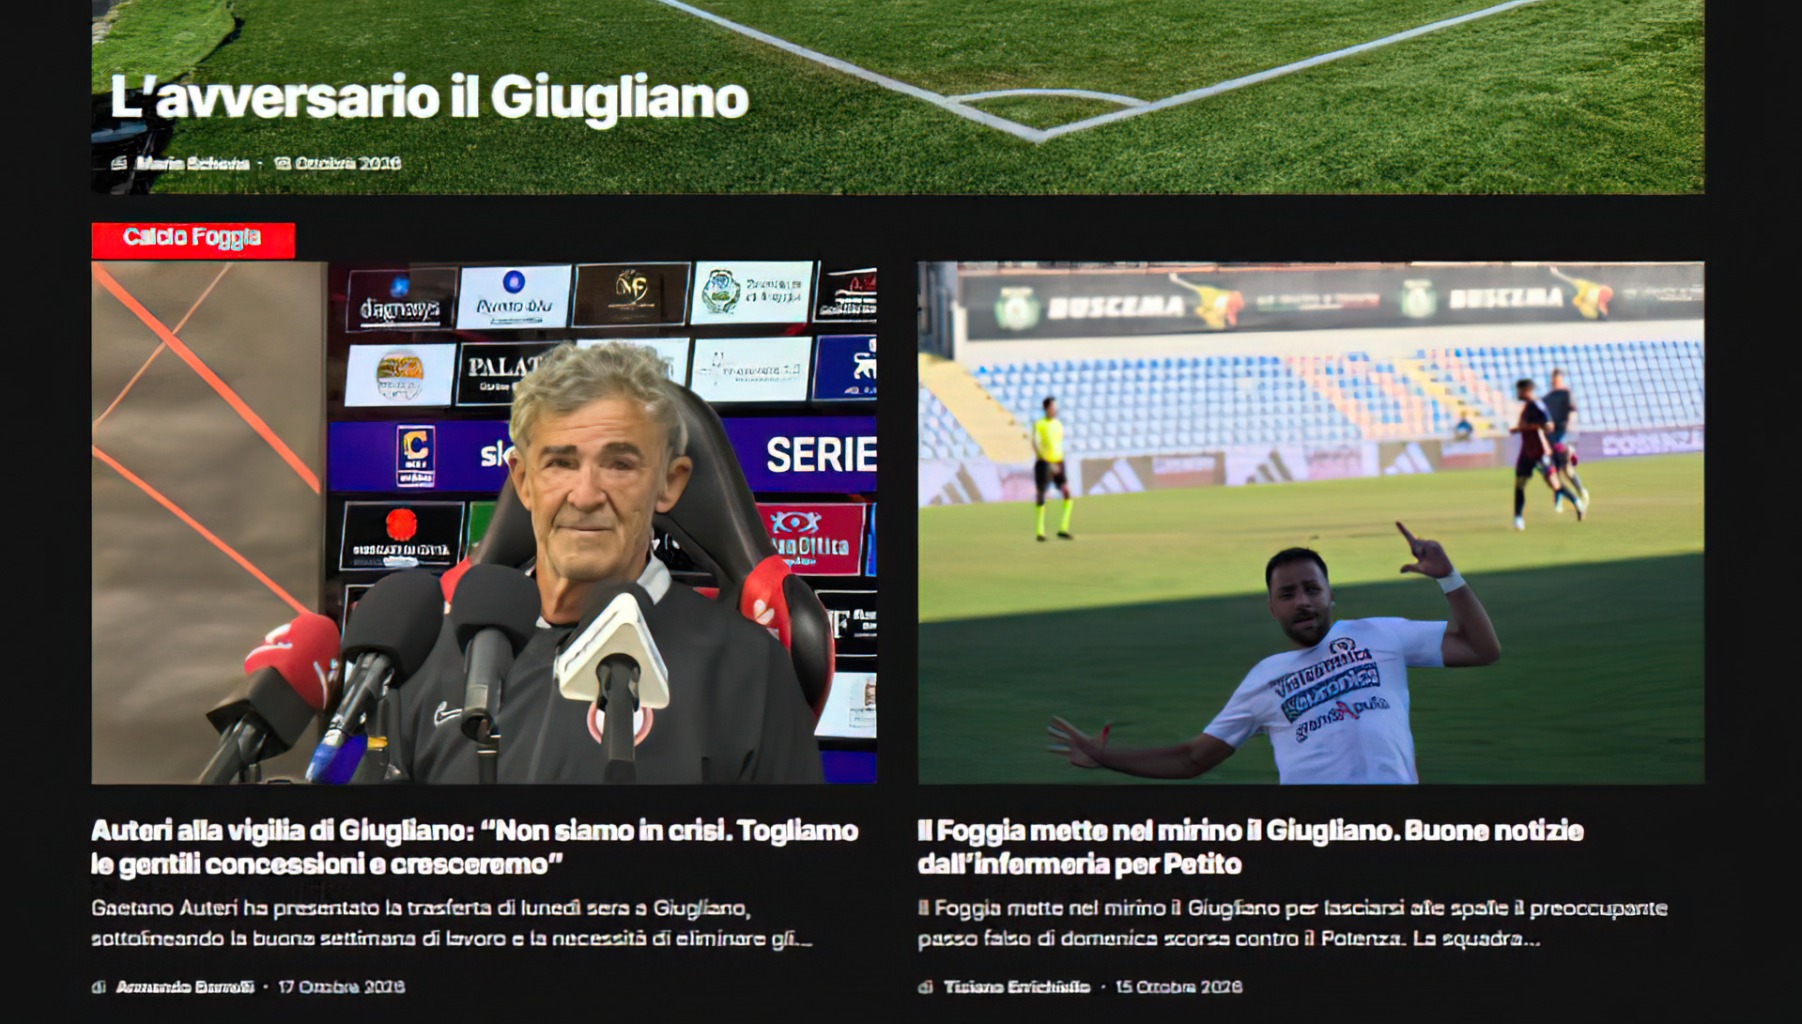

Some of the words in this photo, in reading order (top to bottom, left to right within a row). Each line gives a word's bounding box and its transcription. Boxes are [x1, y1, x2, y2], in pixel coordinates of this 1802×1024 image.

[451, 72, 479, 118] il
[491, 72, 749, 130] Giugliano
[123, 228, 187, 245] Calcio
[192, 228, 261, 251] Foggia
[767, 436, 877, 472] SERIE
[91, 818, 172, 841] Auteri
[178, 818, 223, 841] alla
[228, 817, 305, 847] vigilia
[310, 817, 334, 841] di
[340, 817, 474, 847] Giugliano:
[555, 817, 634, 841] siamo
[639, 817, 663, 841] in
[669, 817, 733, 841] crisi.
[737, 817, 859, 847] Togliamo
[918, 819, 932, 841] Il
[938, 817, 1026, 847] Foggia
[1031, 819, 1108, 841] mette
[1113, 818, 1153, 841] nel
[1158, 817, 1243, 841] mirino
[1247, 817, 1262, 841] il
[1267, 817, 1401, 847] Giugliano.
[1405, 818, 1489, 841] Buone
[1495, 817, 1584, 841] notizie
[91, 851, 114, 875] le
[119, 851, 201, 881] gentili
[205, 851, 365, 875] concessioni
[370, 857, 386, 875] e
[1115, 856, 1160, 881] per
[1164, 852, 1242, 875] Petito
[92, 899, 174, 916] Gaetano
[180, 899, 237, 916] Auteri
[244, 899, 268, 916] ha
[274, 901, 379, 921] presentato
[386, 899, 402, 916] la
[408, 898, 492, 916] trasferta
[498, 899, 516, 916] di
[587, 903, 630, 916] sera
[636, 903, 647, 916] a
[654, 898, 751, 921] Giugliano,
[919, 899, 929, 916] Il
[936, 899, 1001, 921] Foggia
[1008, 901, 1063, 916] mette
[1069, 899, 1098, 916] nel
[1105, 898, 1166, 916] mirino
[1172, 899, 1181, 916] il
[1189, 899, 1280, 921] Giugliano
[1286, 903, 1318, 921] per
[1325, 899, 1404, 916] lasciarsi
[1411, 899, 1445, 916] alle
[1451, 899, 1508, 921] spalle
[1515, 899, 1524, 916] il
[1530, 901, 1668, 921] preoccupante
[92, 930, 224, 946] sottolineando
[231, 930, 247, 946] la
[253, 930, 315, 946] buona
[321, 930, 416, 946] settimana
[423, 930, 440, 946] di
[447, 930, 506, 946] lavoro
[512, 935, 524, 946] e
[531, 930, 547, 946] la
[553, 929, 647, 946] necessità
[653, 929, 671, 946] di
[676, 929, 766, 946] eliminare
[918, 934, 978, 951] passo
[984, 929, 1031, 946] falso
[1038, 929, 1055, 946] di
[1061, 929, 1158, 946] domenica
[1164, 934, 1230, 946] scorsa
[1236, 932, 1299, 946] contro
[1305, 929, 1314, 946] il
[1322, 930, 1407, 946] Potenza.
[1414, 930, 1436, 946] La
